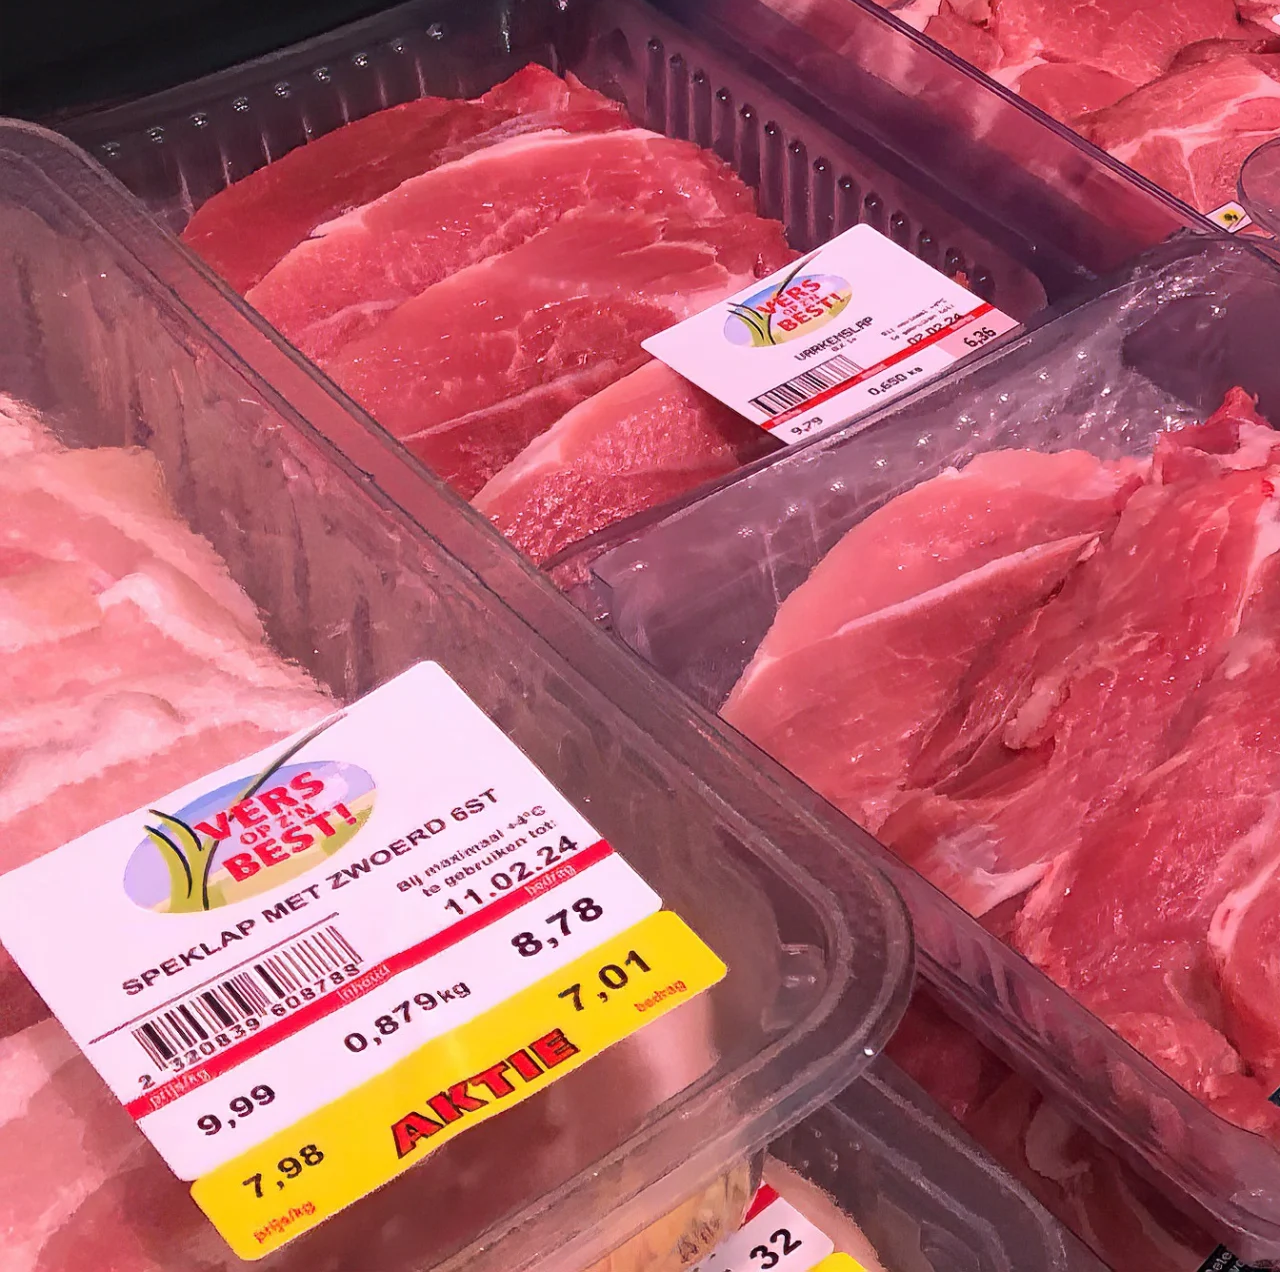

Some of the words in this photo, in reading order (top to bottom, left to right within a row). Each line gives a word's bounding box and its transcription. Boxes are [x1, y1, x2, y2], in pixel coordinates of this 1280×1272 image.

[756, 278, 821, 315] VERS
[777, 292, 845, 332] BEST!
[193, 771, 325, 842] VERS
[239, 823, 271, 845] OP
[222, 802, 357, 883] BEST!
[122, 918, 256, 996] SPEKLAP
[261, 883, 321, 923] MET
[326, 818, 447, 890] ZWOERD
[450, 787, 500, 822] 6ST
[443, 834, 579, 916] 11.02.24
[510, 896, 604, 958] 8,78
[557, 949, 652, 1012] 7,01
[196, 1083, 276, 1137] 9,99
[390, 1027, 582, 1160] AKTIE
[242, 1143, 325, 1199] 7,98
